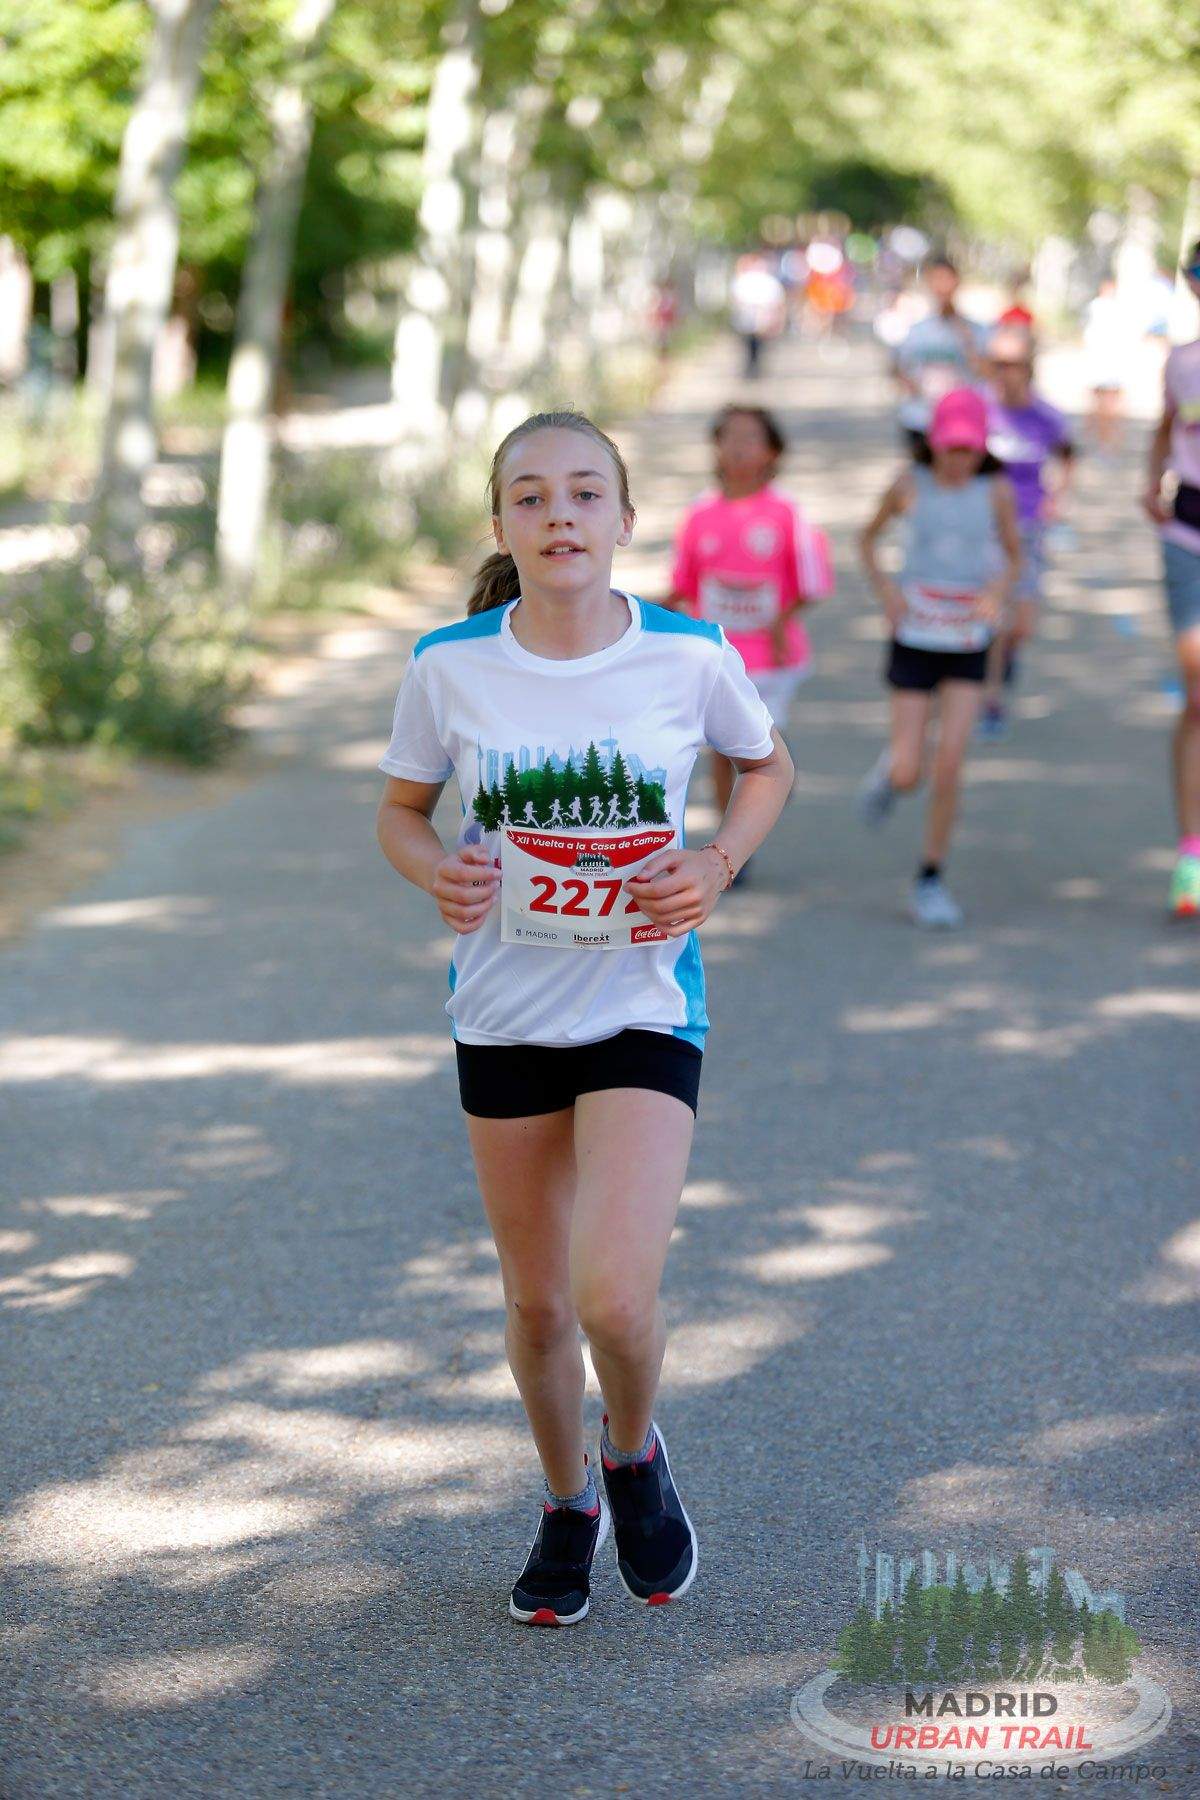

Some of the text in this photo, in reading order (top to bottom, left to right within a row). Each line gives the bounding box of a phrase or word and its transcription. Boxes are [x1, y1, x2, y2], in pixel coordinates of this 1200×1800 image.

[516, 835, 667, 851] XII Vuelta a la Casa de Campo
[525, 930, 558, 940] MADRID
